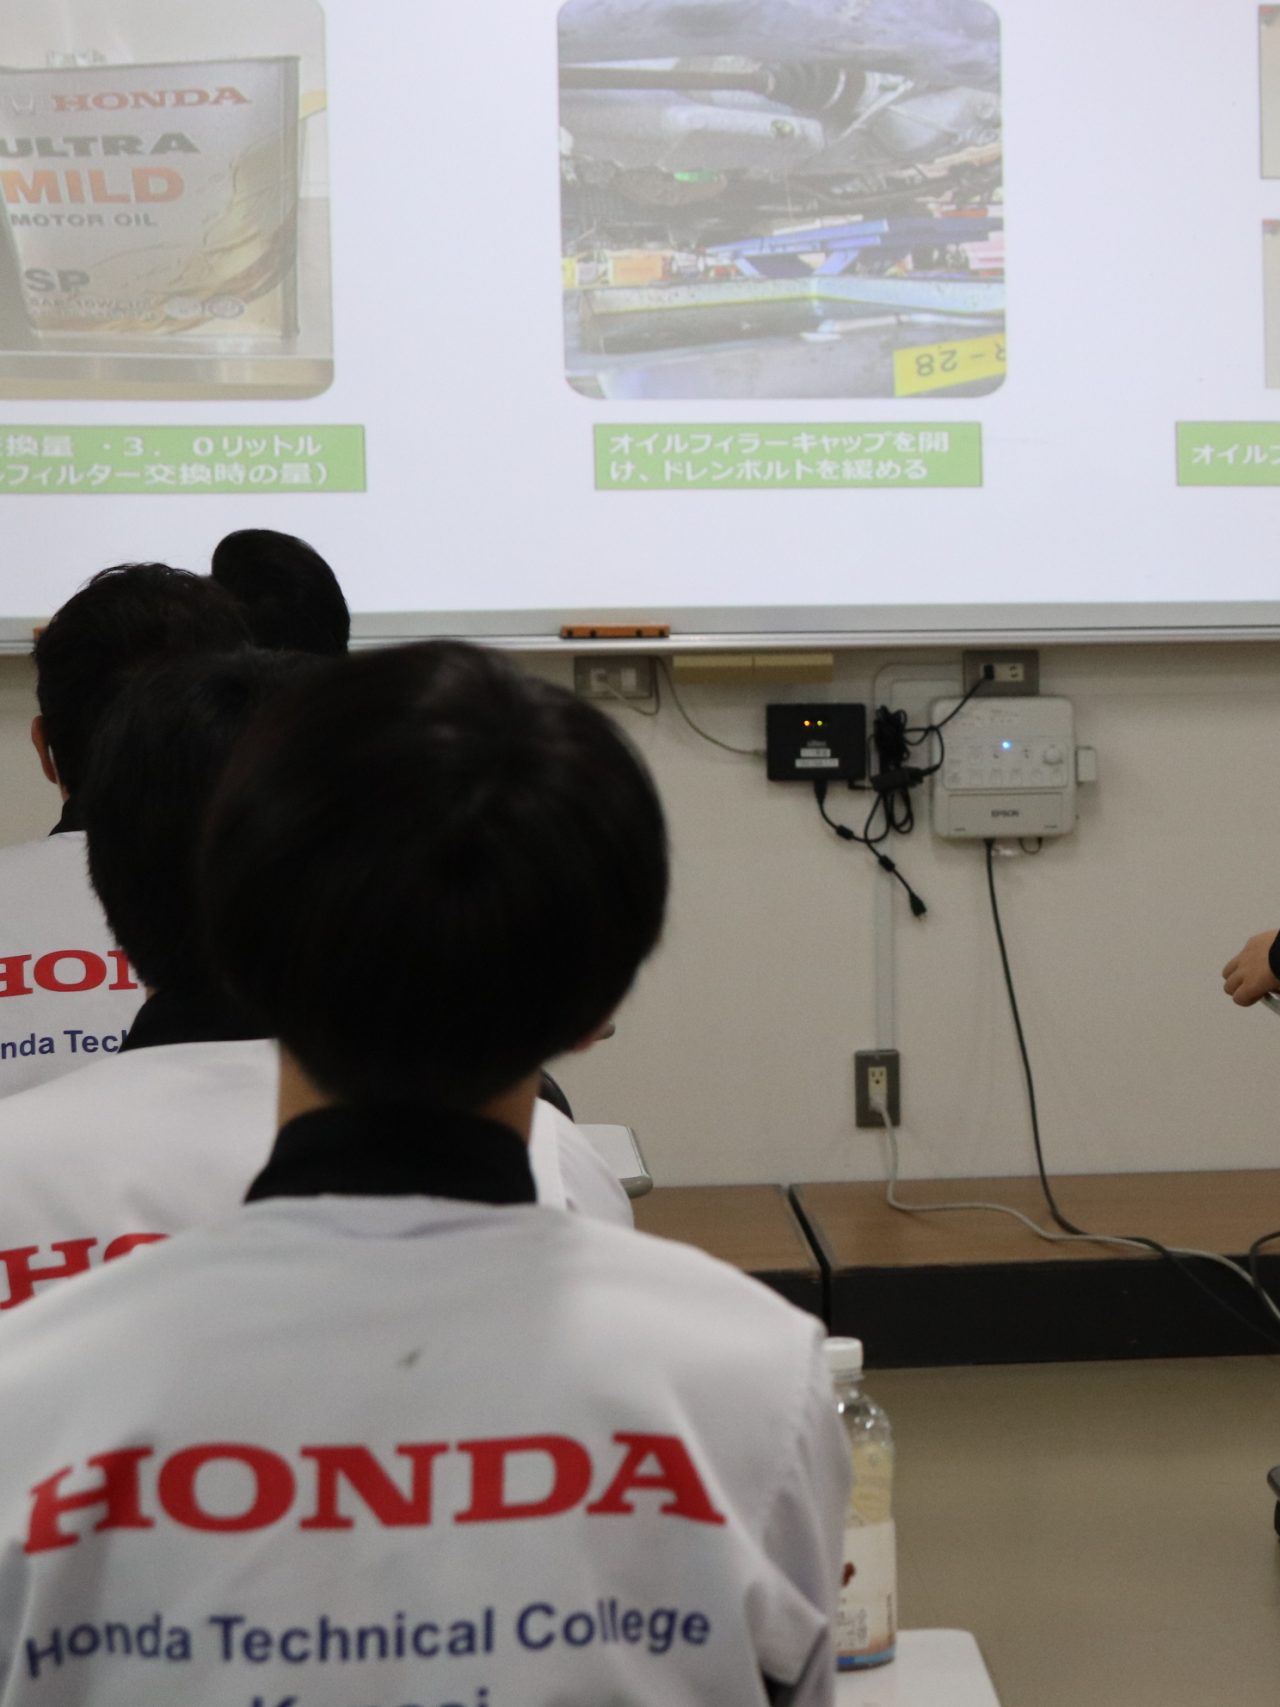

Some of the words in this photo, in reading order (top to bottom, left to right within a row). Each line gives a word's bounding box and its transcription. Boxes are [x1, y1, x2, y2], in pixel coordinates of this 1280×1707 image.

[53, 86, 250, 112] HONDA
[0, 132, 201, 158] ULTRA
[0, 167, 185, 204] MILD
[10, 213, 105, 227] MOTOR
[113, 213, 157, 227] OIL
[24, 268, 91, 293] SP
[0, 435, 74, 458] 換量
[609, 431, 950, 455] オイルフィラーキャップを開
[0, 462, 329, 487] フィルター交換時の量)
[0, 1032, 56, 1060] nda
[22, 1430, 728, 1556] HONDA
[25, 1612, 193, 1679] Honda
[208, 1606, 495, 1664] Technical
[515, 1597, 711, 1656] College
